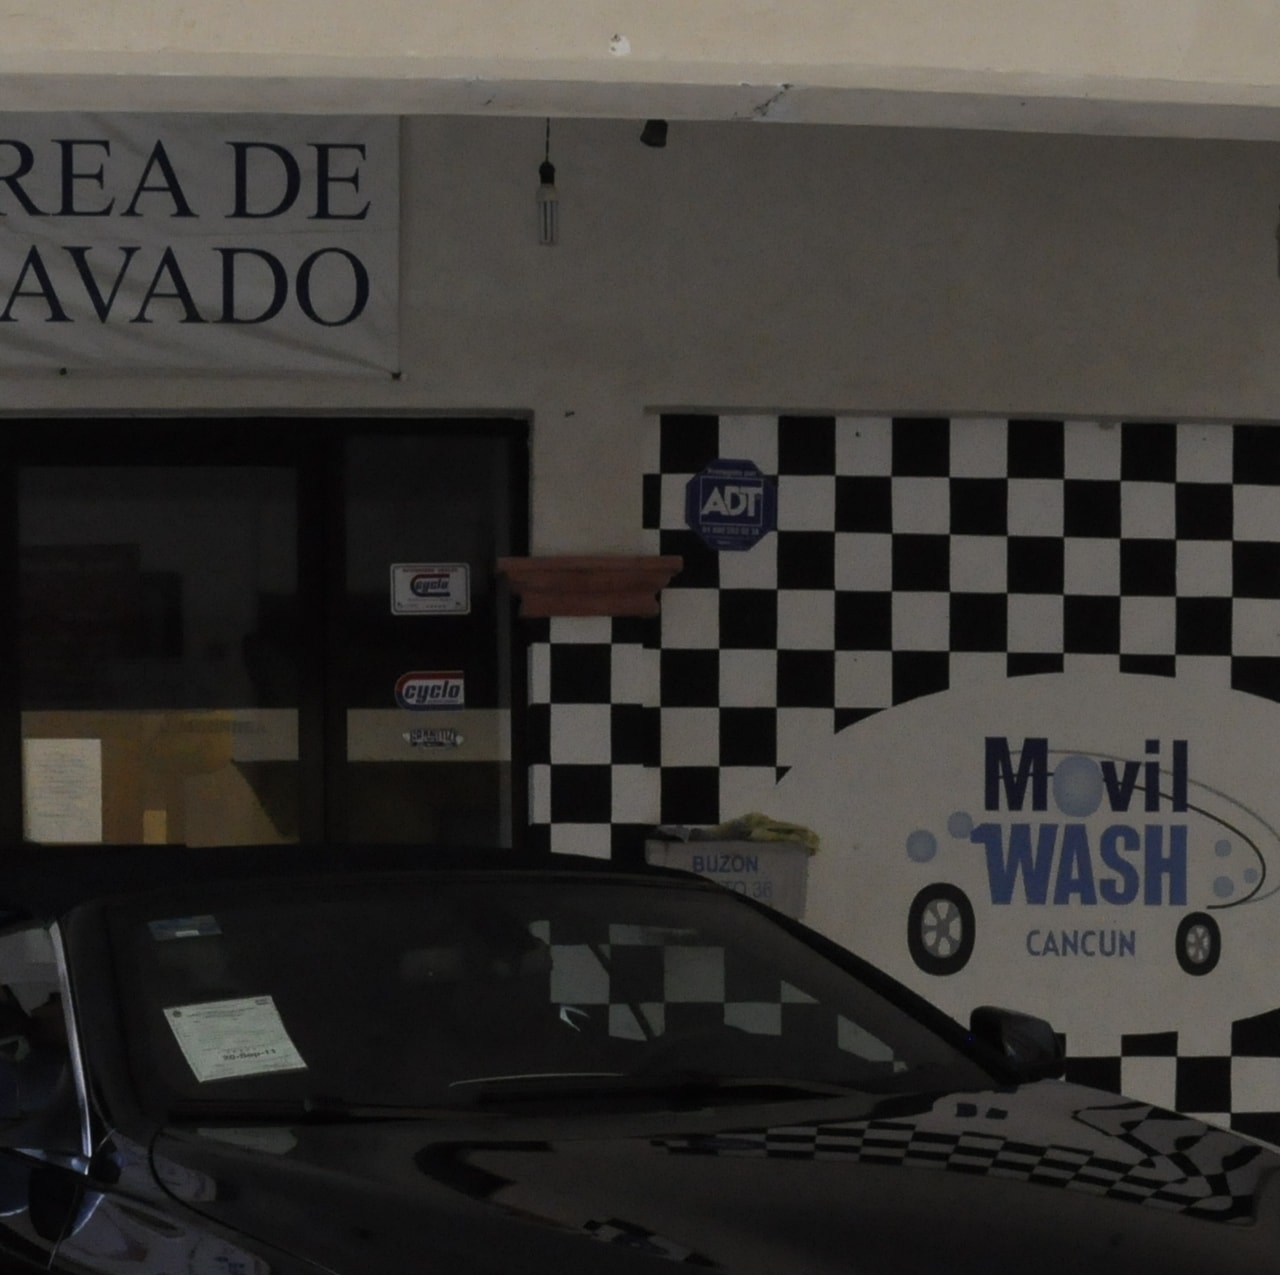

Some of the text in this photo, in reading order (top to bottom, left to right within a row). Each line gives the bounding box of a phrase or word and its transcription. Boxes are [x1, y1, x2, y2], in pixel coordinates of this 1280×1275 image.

[224, 141, 372, 221] DE
[701, 485, 764, 518] ADT
[404, 680, 461, 704] cyclo
[691, 854, 759, 874] BUZON
[970, 823, 1188, 907] WASH
[1026, 930, 1136, 958] CANCUN
